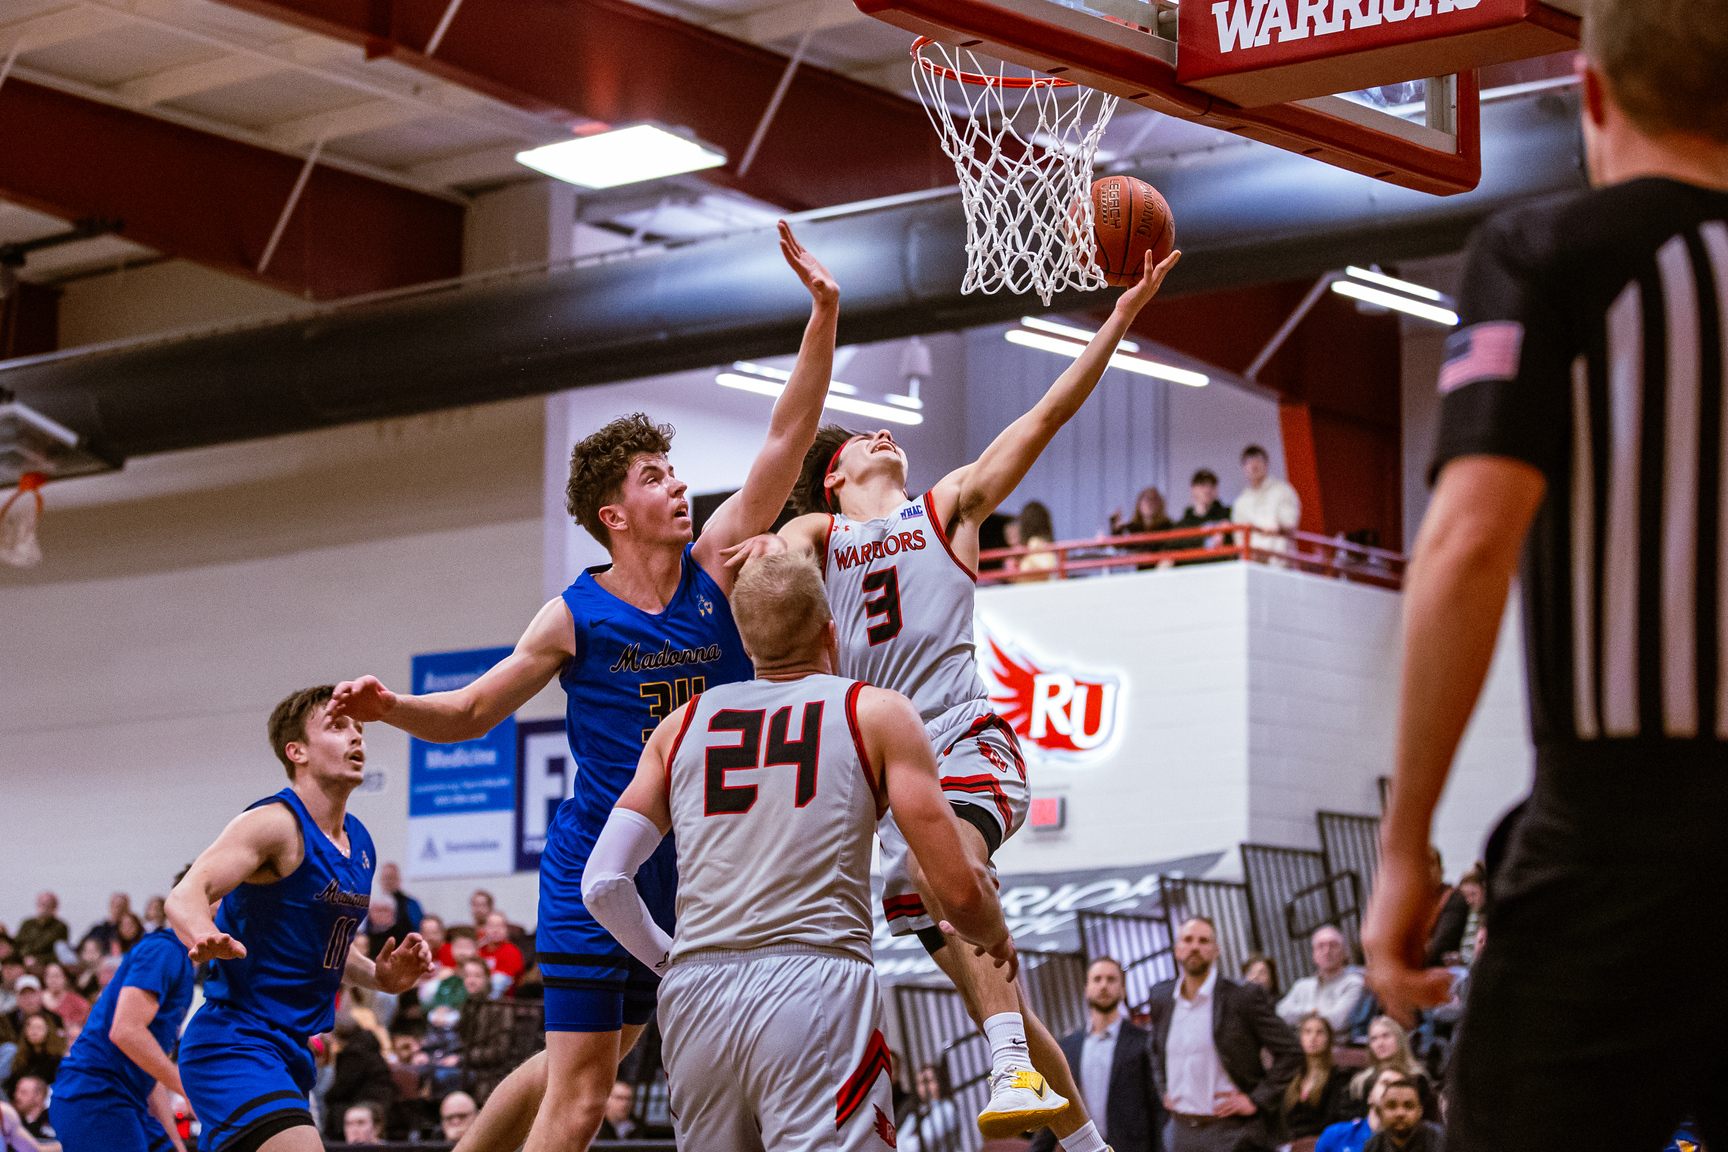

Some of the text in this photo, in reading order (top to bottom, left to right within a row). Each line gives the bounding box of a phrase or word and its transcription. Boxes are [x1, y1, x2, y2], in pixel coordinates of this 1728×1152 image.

[900, 505, 923, 518] WHAC
[834, 530, 926, 571] WARRIORS
[862, 565, 903, 647] 3
[609, 639, 722, 673] Madonna
[1029, 673, 1118, 749] RU
[704, 701, 825, 817] 24
[323, 916, 357, 970] 11
